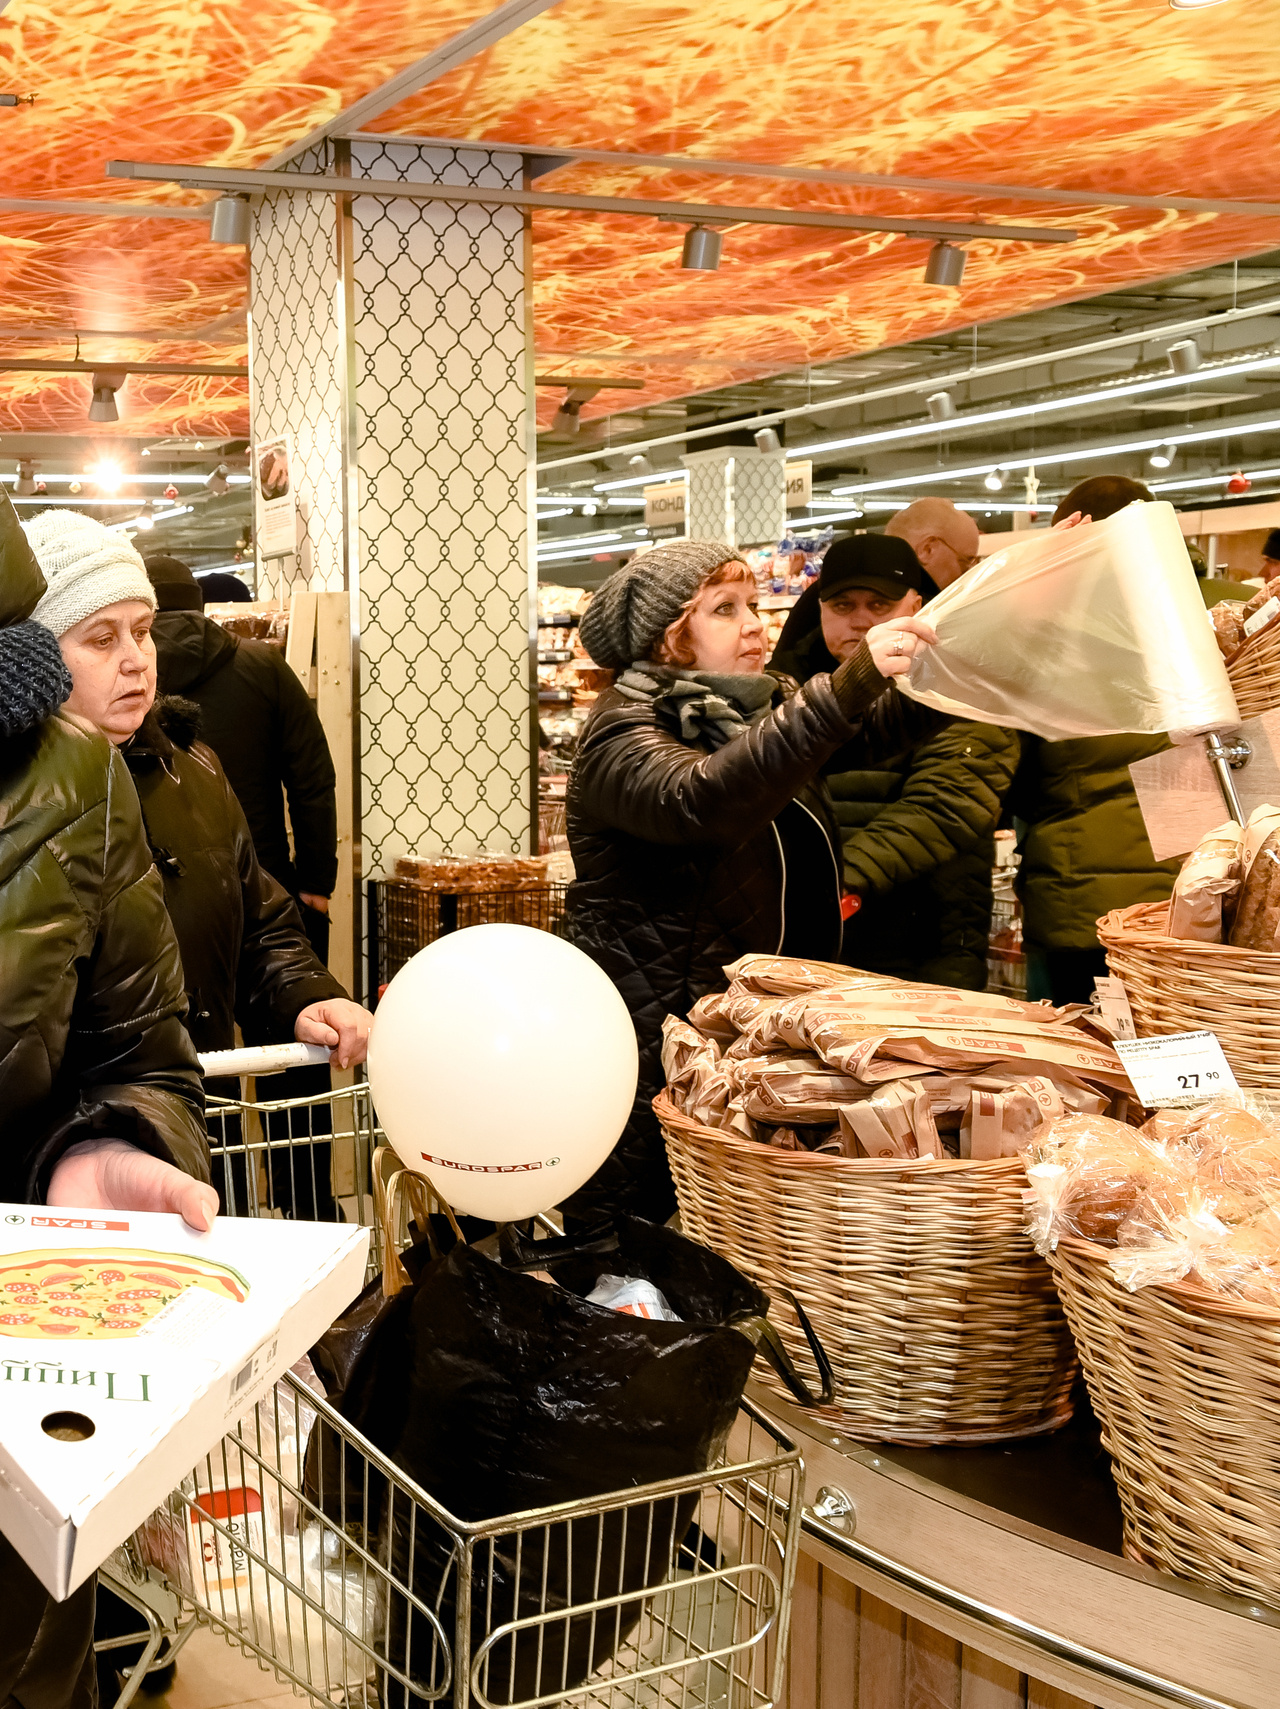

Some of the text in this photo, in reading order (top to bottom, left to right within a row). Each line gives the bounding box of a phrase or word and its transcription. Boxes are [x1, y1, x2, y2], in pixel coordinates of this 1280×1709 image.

[786, 477, 804, 493] ИЯ
[651, 496, 685, 512] КОНД
[963, 1037, 1010, 1050] SPAR
[1177, 1071, 1220, 1089] 27 90
[431, 1156, 542, 1174] EUROSPAR
[32, 1217, 107, 1230] SPAR
